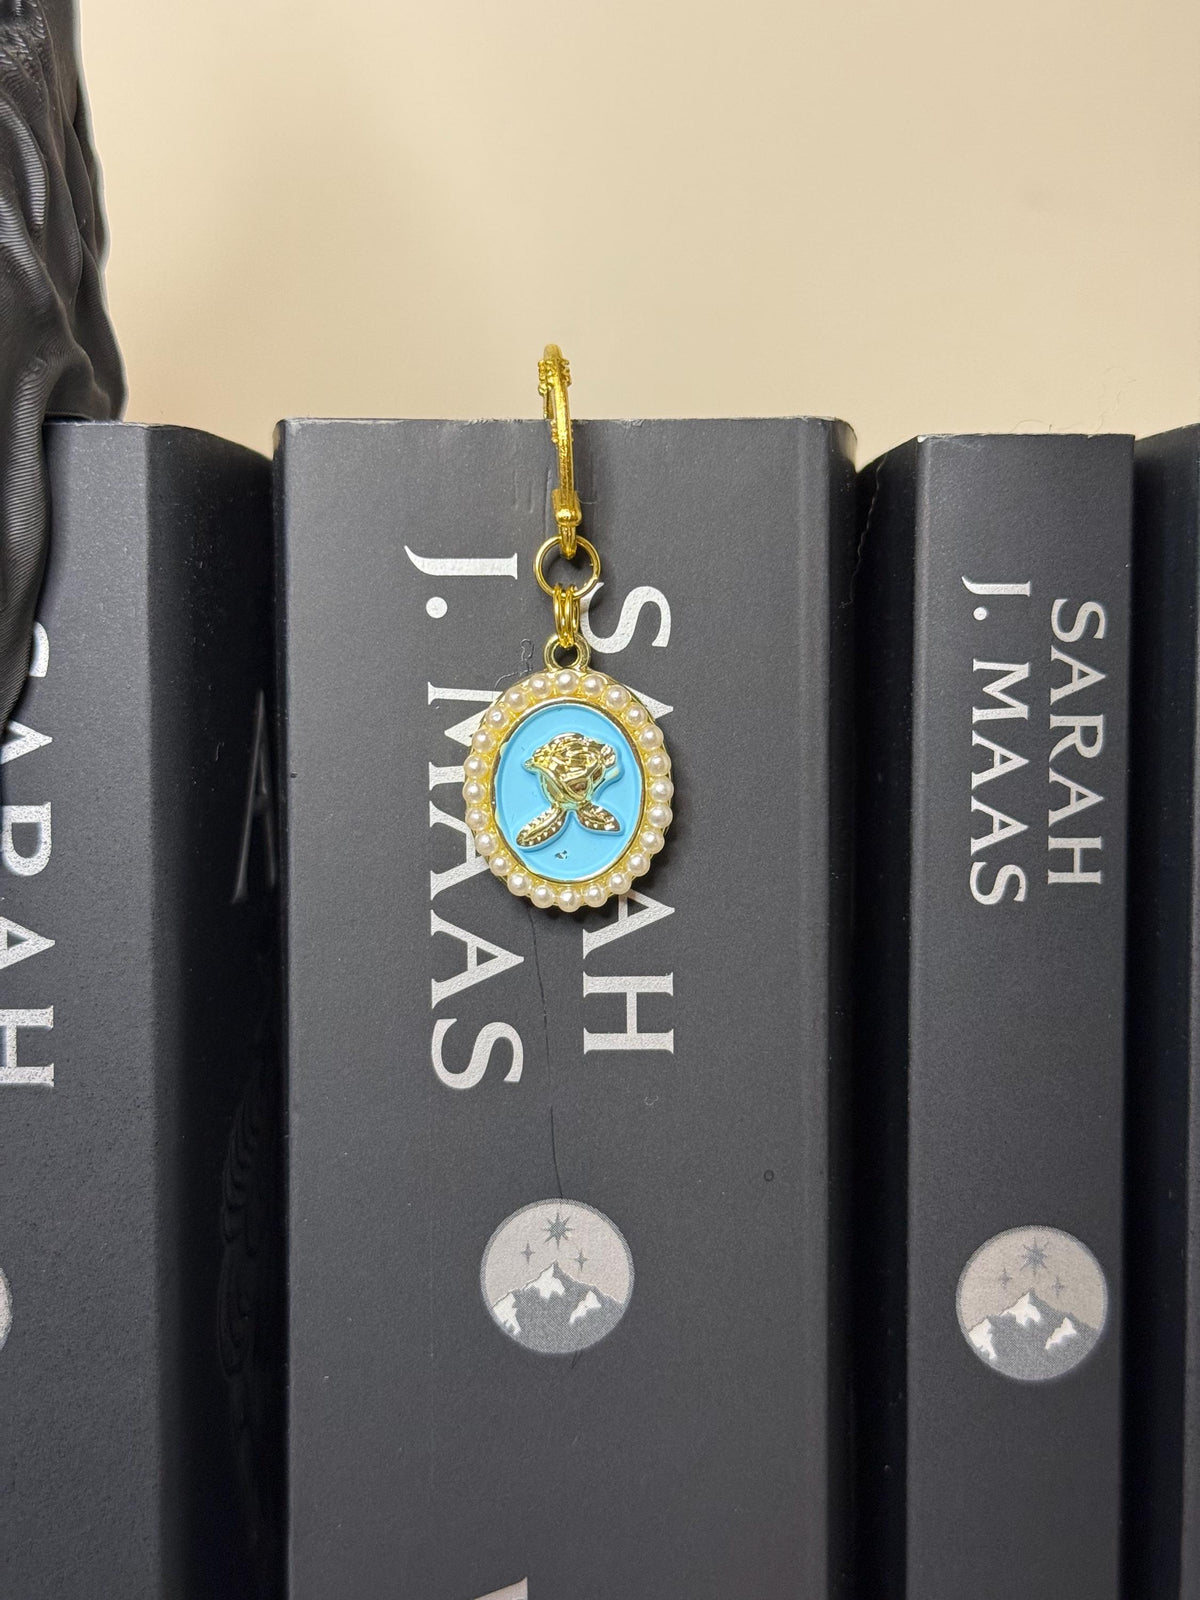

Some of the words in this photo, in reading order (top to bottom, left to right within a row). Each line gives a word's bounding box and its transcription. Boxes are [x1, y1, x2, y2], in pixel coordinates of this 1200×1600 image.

[402, 545, 518, 619] J.
[962, 576, 1031, 620] J.
[0, 622, 55, 1087] RAH
[580, 578, 675, 1054] SAH
[970, 658, 1030, 905] MAAS
[1048, 599, 1105, 884] SARAH
